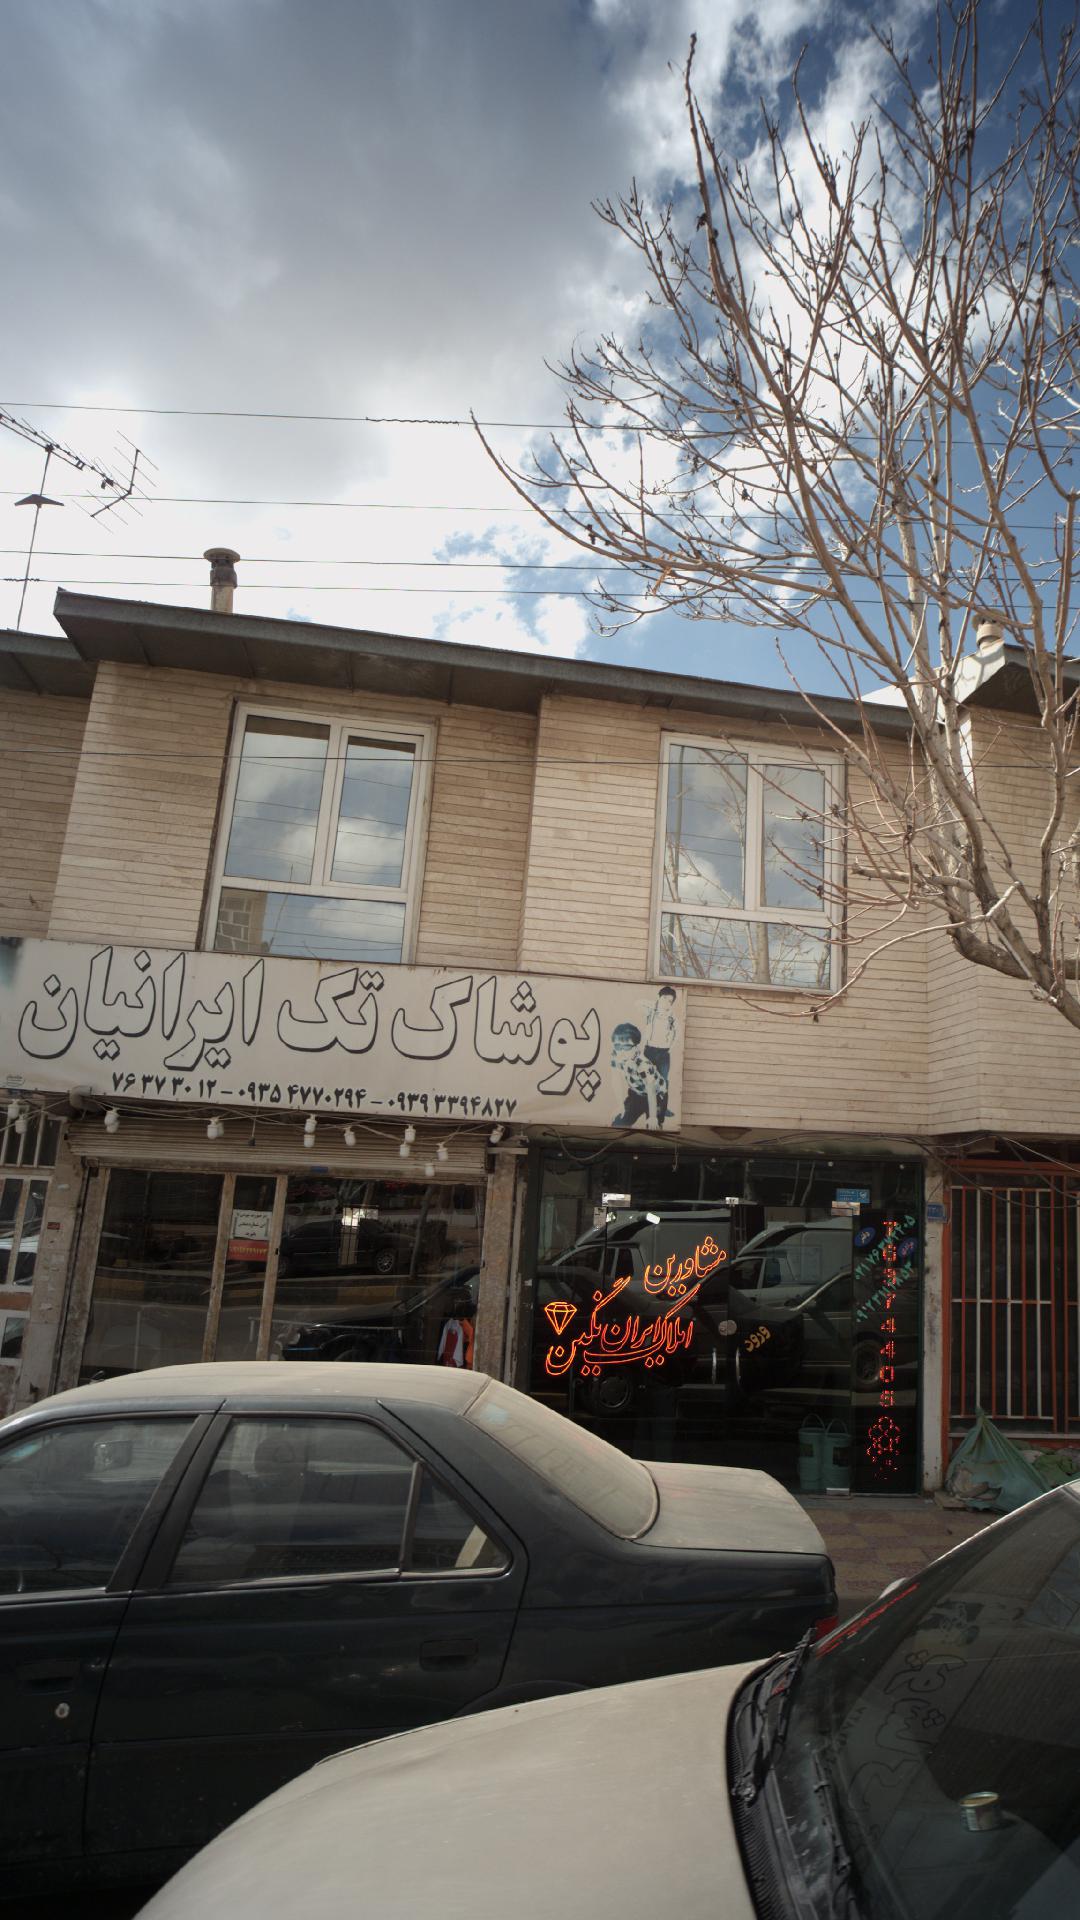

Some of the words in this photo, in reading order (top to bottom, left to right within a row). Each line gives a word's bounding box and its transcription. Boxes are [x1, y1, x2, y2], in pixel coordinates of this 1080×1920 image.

[19, 946, 264, 1070] ایرانیان
[277, 968, 384, 1052] تک
[392, 975, 600, 1101] پوشاک
[644, 1235, 727, 1297] مشاورین
[744, 1325, 772, 1352] ورود
